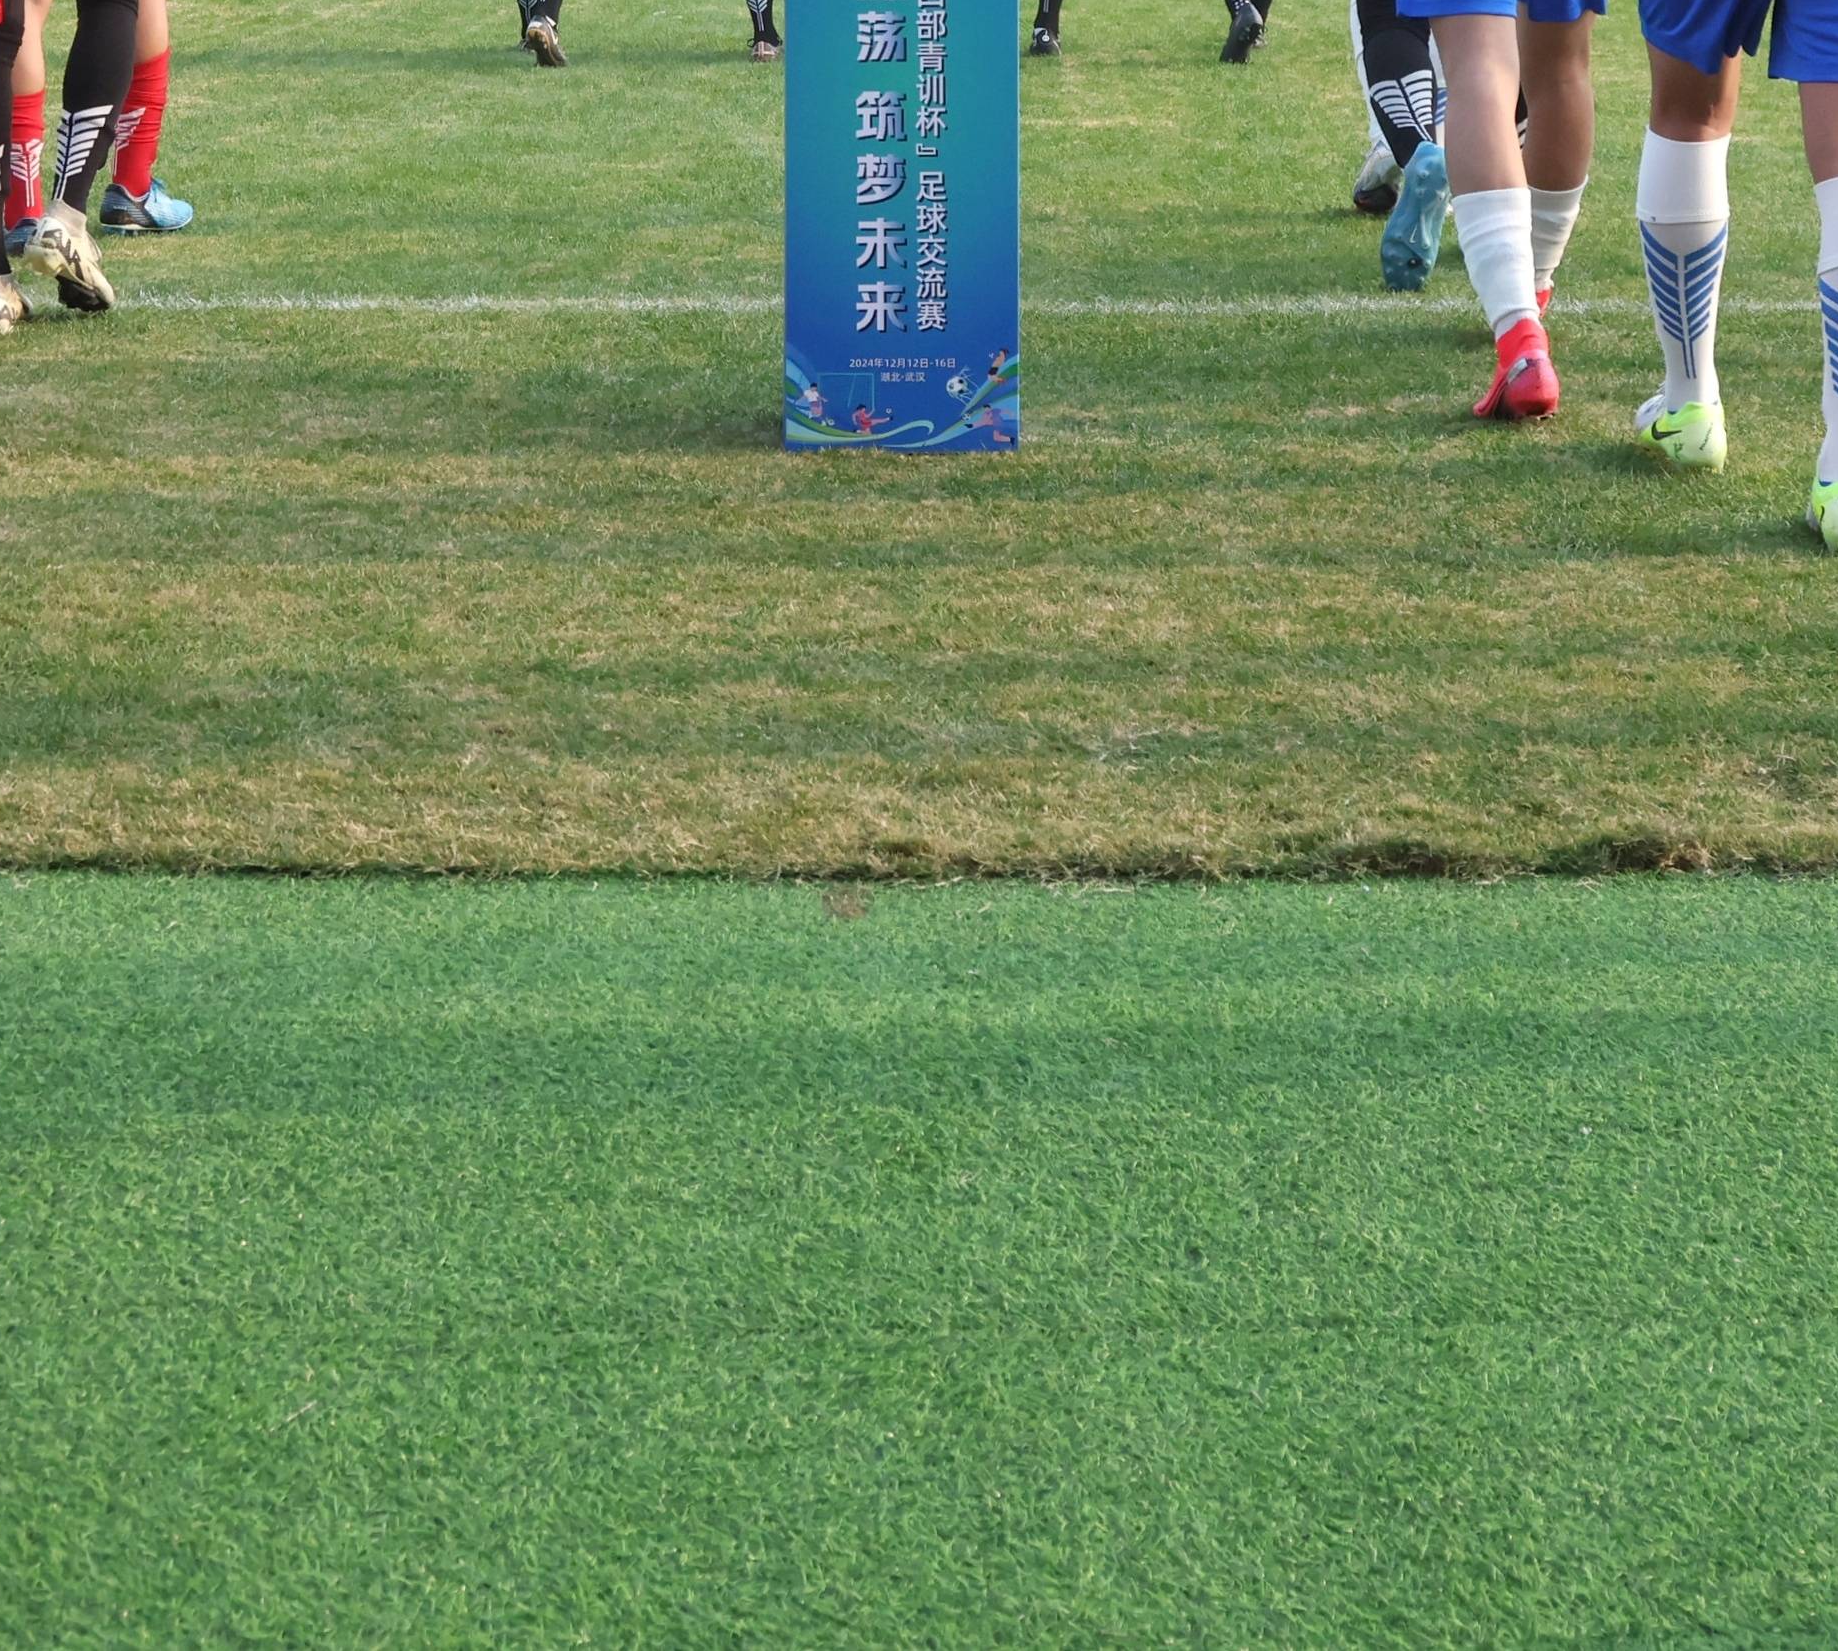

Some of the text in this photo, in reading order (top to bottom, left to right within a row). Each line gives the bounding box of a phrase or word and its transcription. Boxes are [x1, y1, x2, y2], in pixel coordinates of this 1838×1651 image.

[854, 90, 908, 333] 筑梦未来
[848, 357, 957, 369] 2024年12月12日-16日
